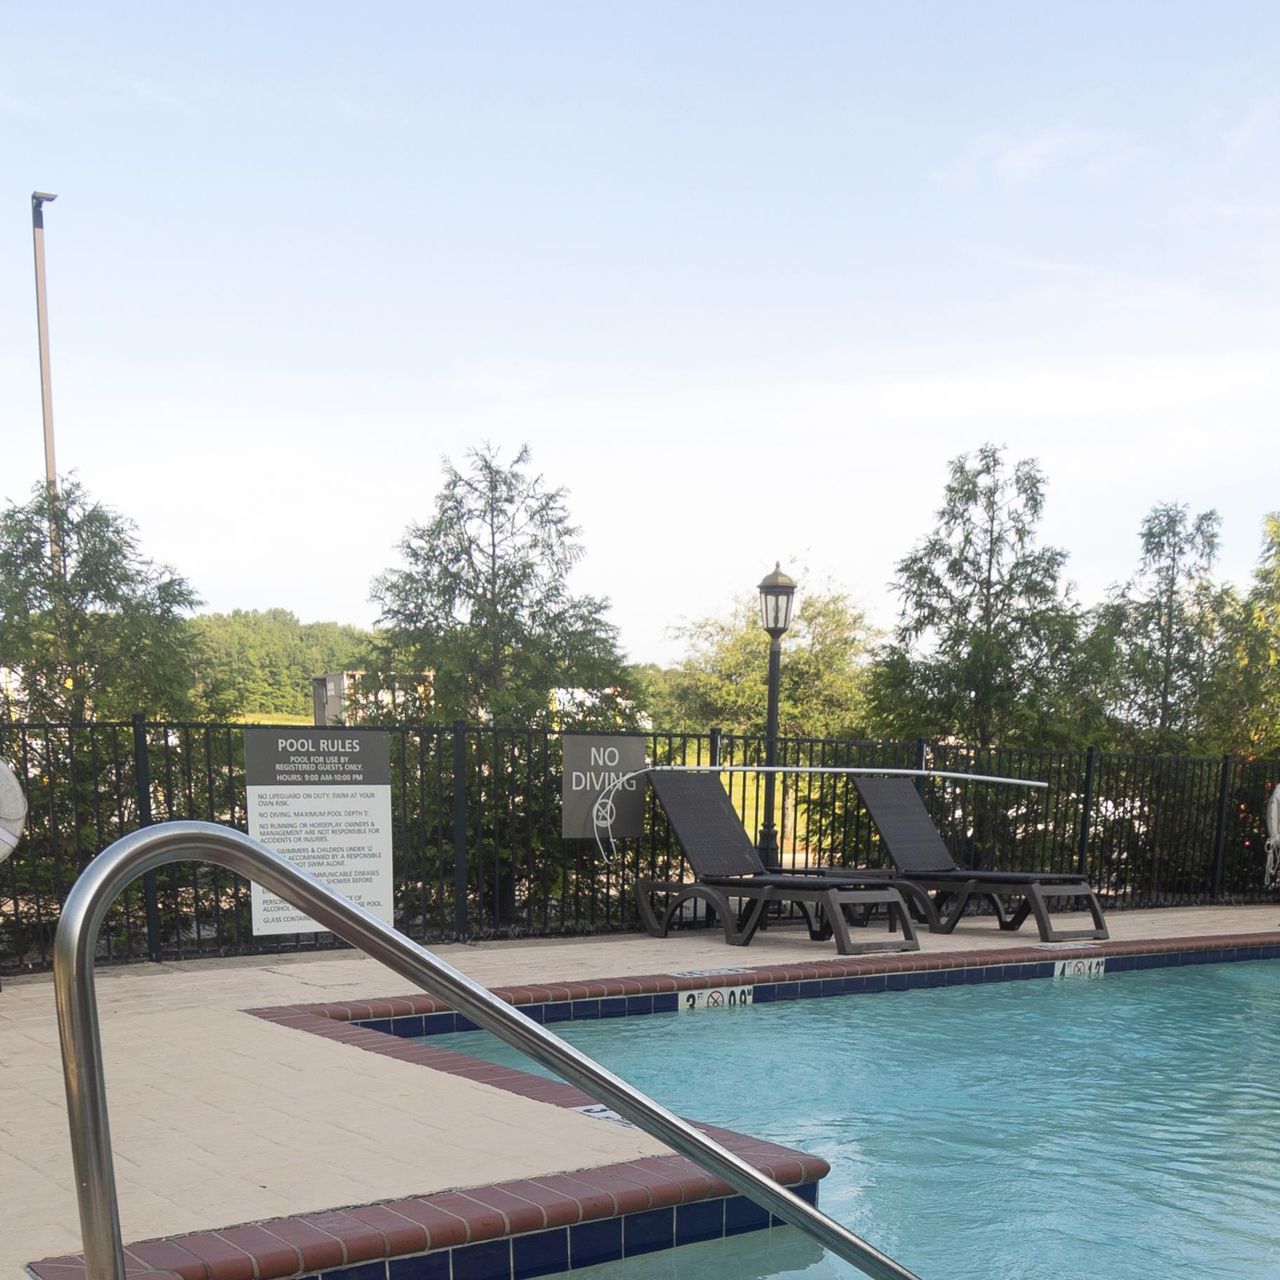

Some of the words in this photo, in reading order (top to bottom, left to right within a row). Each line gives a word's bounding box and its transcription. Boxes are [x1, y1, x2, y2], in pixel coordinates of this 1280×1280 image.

[278, 739, 316, 752] POOL
[320, 739, 360, 752] RULES
[591, 747, 619, 766] NO
[275, 763, 316, 771] REGISTERED
[317, 763, 343, 771] GUESTS
[345, 763, 363, 771] ONLY.
[572, 771, 636, 791] DIVING
